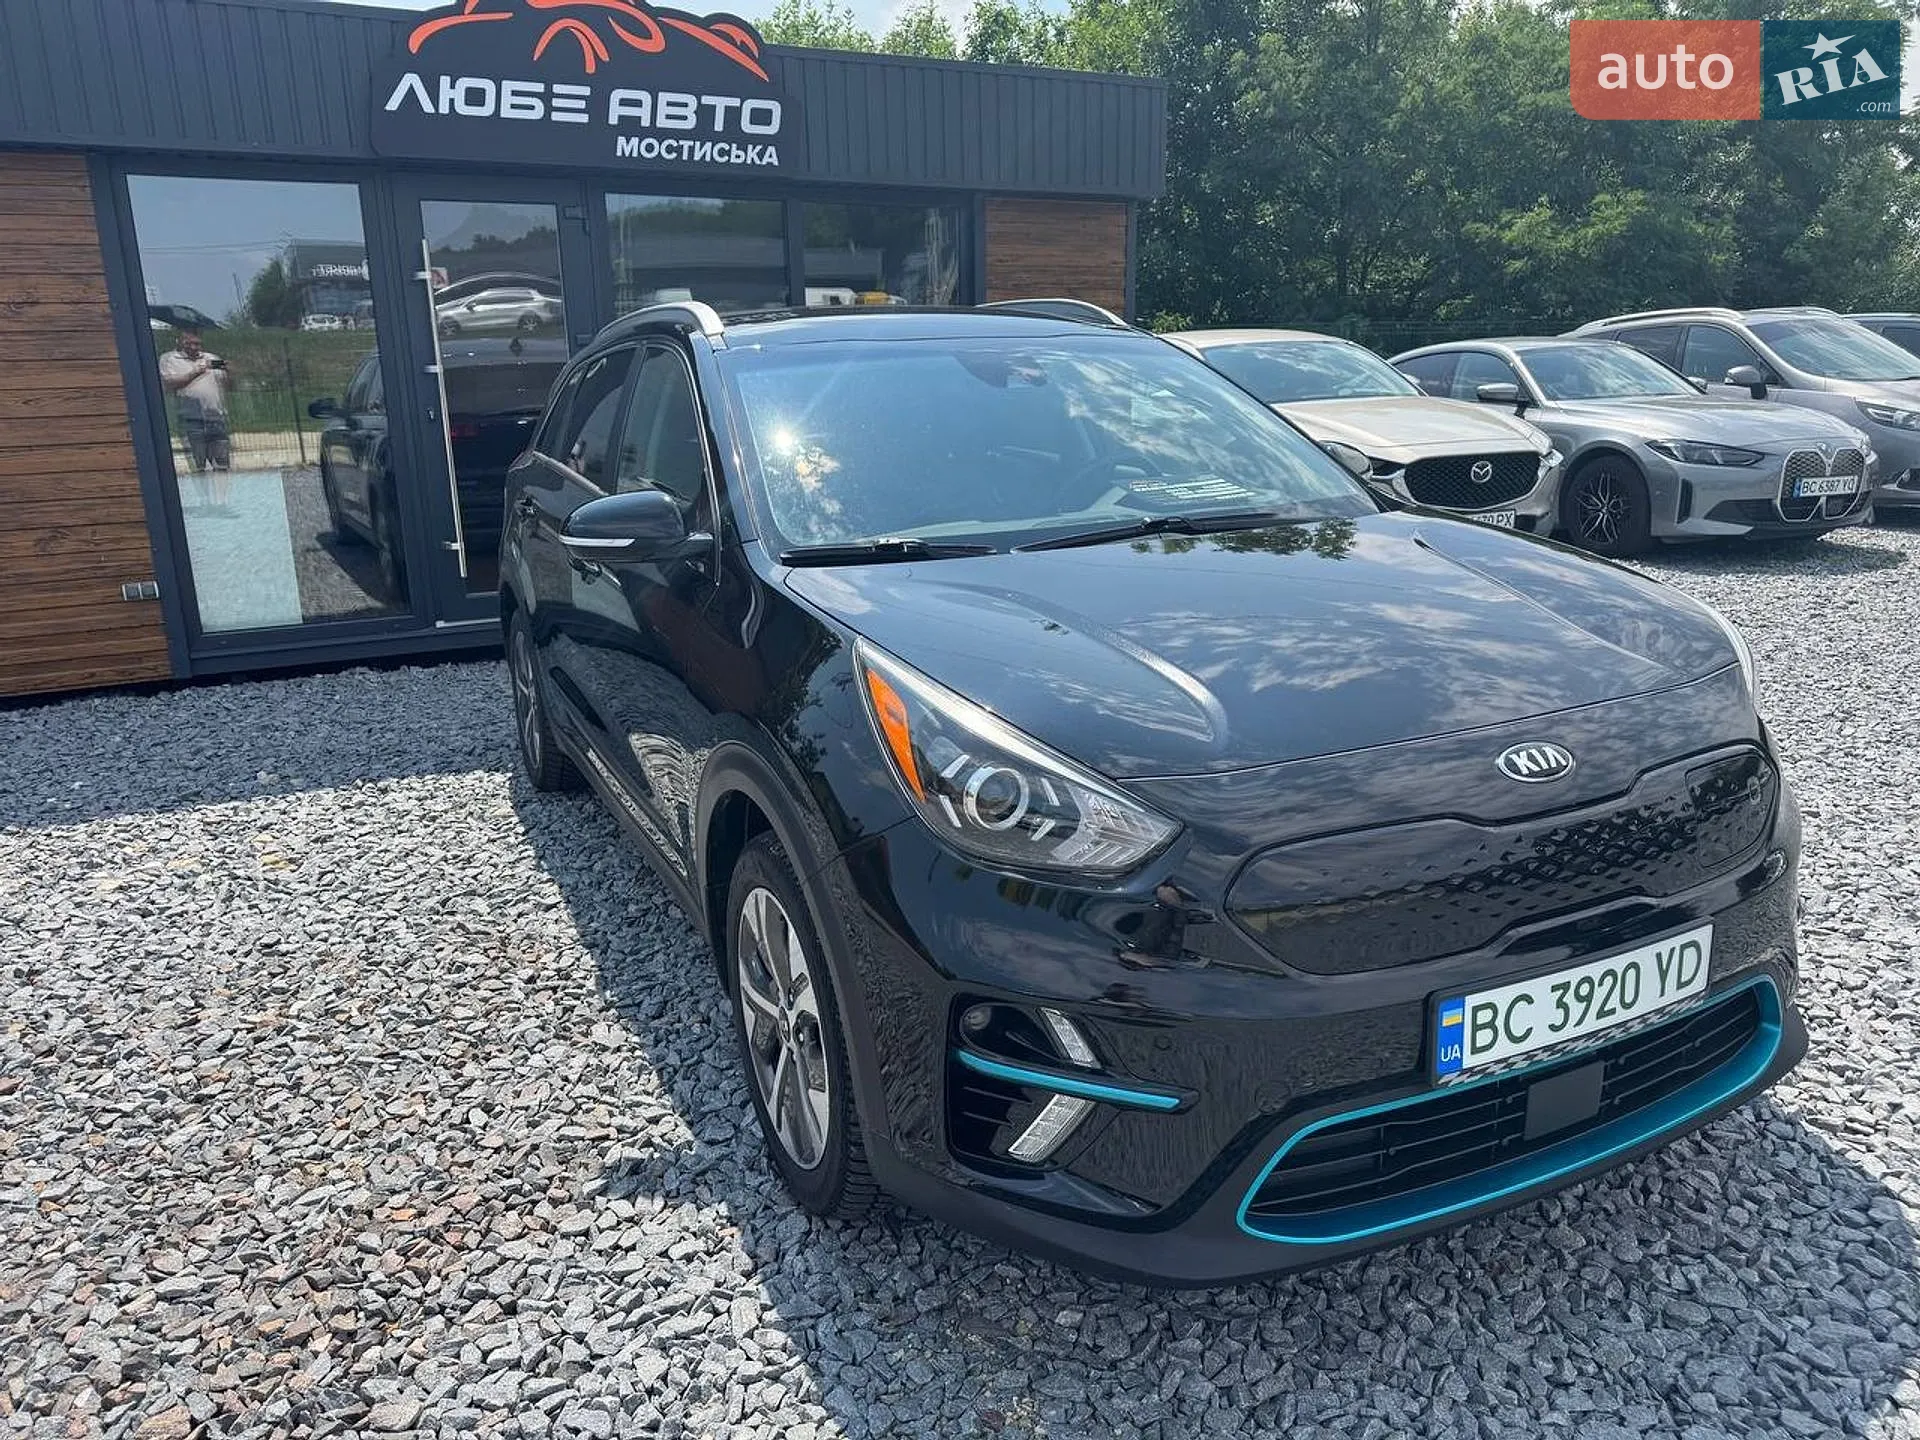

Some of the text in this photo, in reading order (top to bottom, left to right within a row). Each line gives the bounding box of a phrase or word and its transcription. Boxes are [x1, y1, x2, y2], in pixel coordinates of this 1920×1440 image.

[384, 72, 782, 135] ЛЮБЕ АВТО
[616, 136, 780, 167] МОСТИСЬКА
[1508, 746, 1568, 775] KIA
[1470, 939, 1703, 1055] BC 3920 YD
[1440, 1043, 1461, 1063] UA
